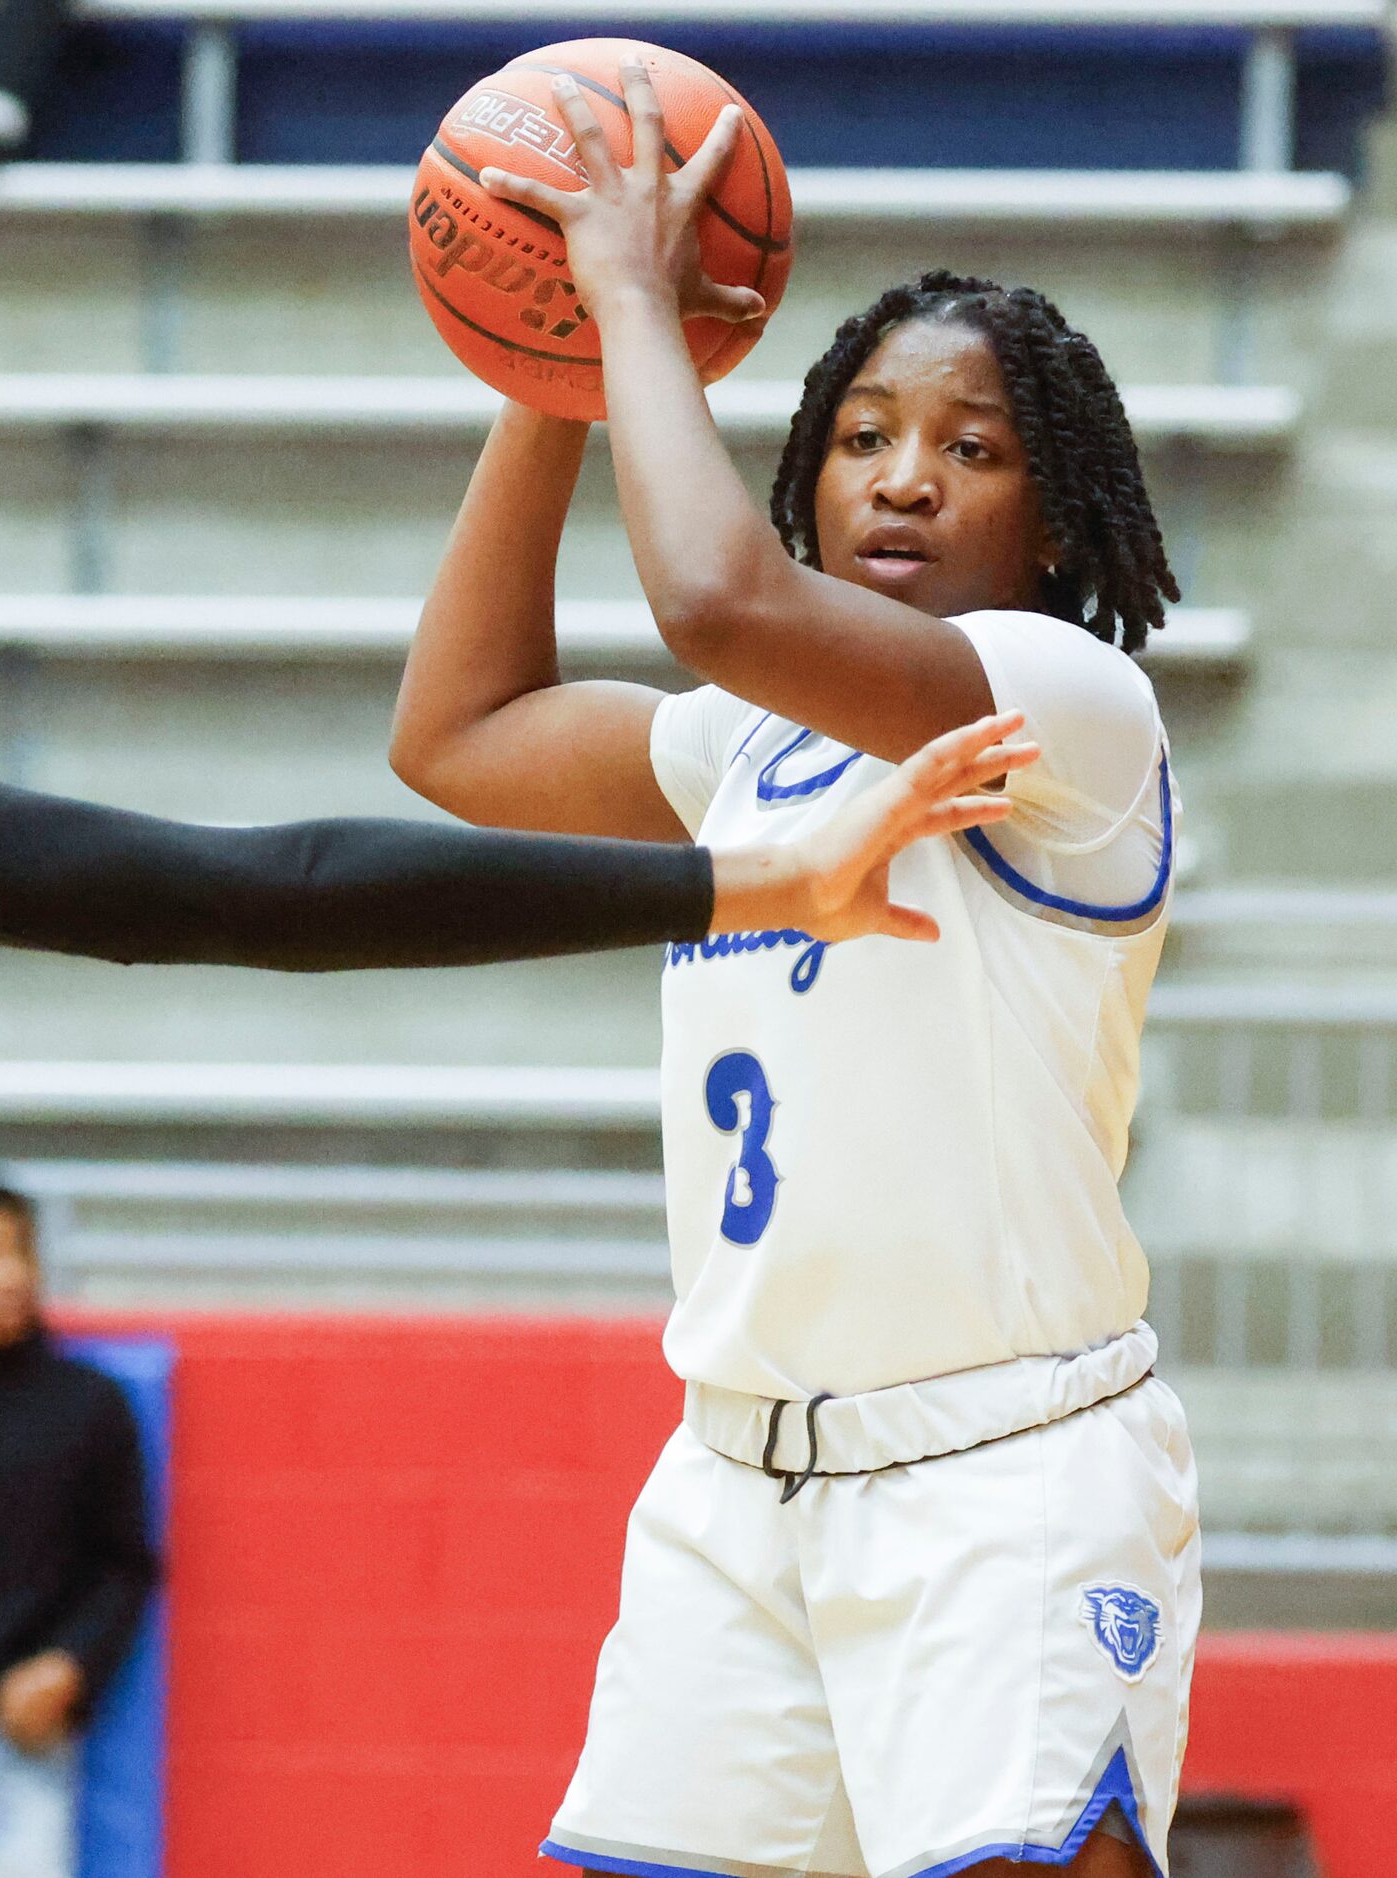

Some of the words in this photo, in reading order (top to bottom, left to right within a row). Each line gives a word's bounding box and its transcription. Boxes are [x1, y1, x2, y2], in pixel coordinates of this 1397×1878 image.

[460, 94, 525, 133] PRO
[441, 187, 567, 267] PERFECTION
[702, 1047, 786, 1250] 3
